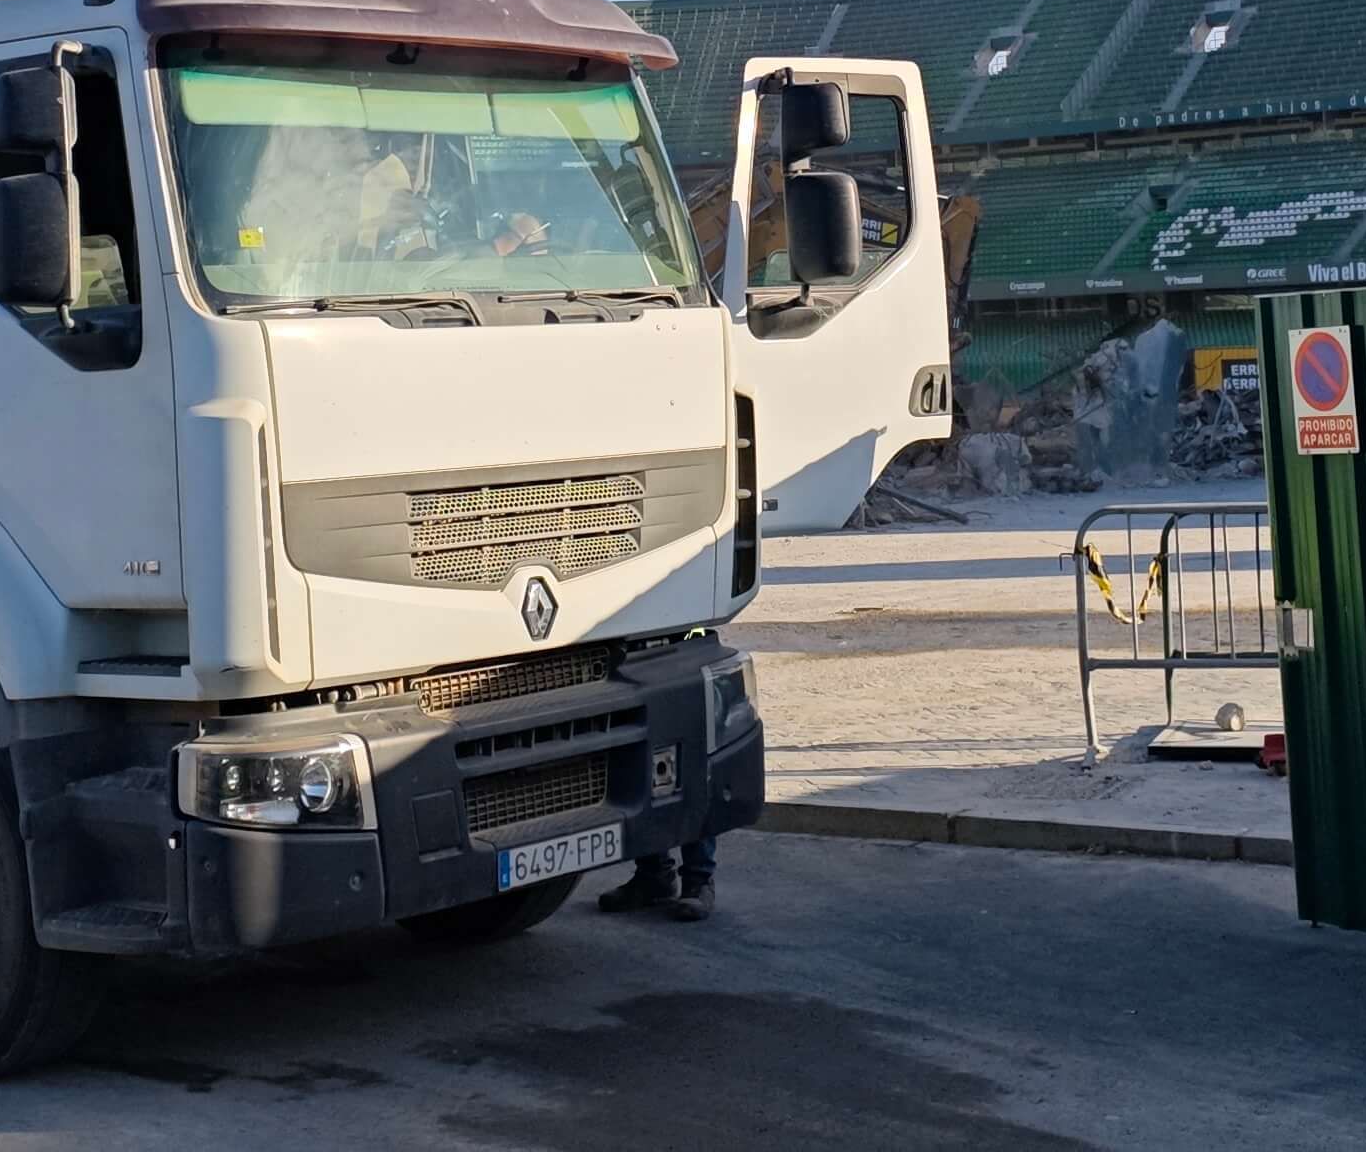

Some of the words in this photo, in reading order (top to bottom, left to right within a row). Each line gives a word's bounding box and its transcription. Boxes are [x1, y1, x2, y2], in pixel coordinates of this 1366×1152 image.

[1119, 116, 1139, 129] De
[1155, 108, 1225, 127] padres
[861, 218, 882, 230] RRI
[861, 229, 881, 241] RRI
[1308, 263, 1339, 283] Viva
[1341, 262, 1355, 280] el
[1298, 418, 1354, 432] PROHIBIDO
[1303, 432, 1352, 446] APARCAR
[514, 841, 569, 881] 6497
[577, 829, 617, 866] FPB
